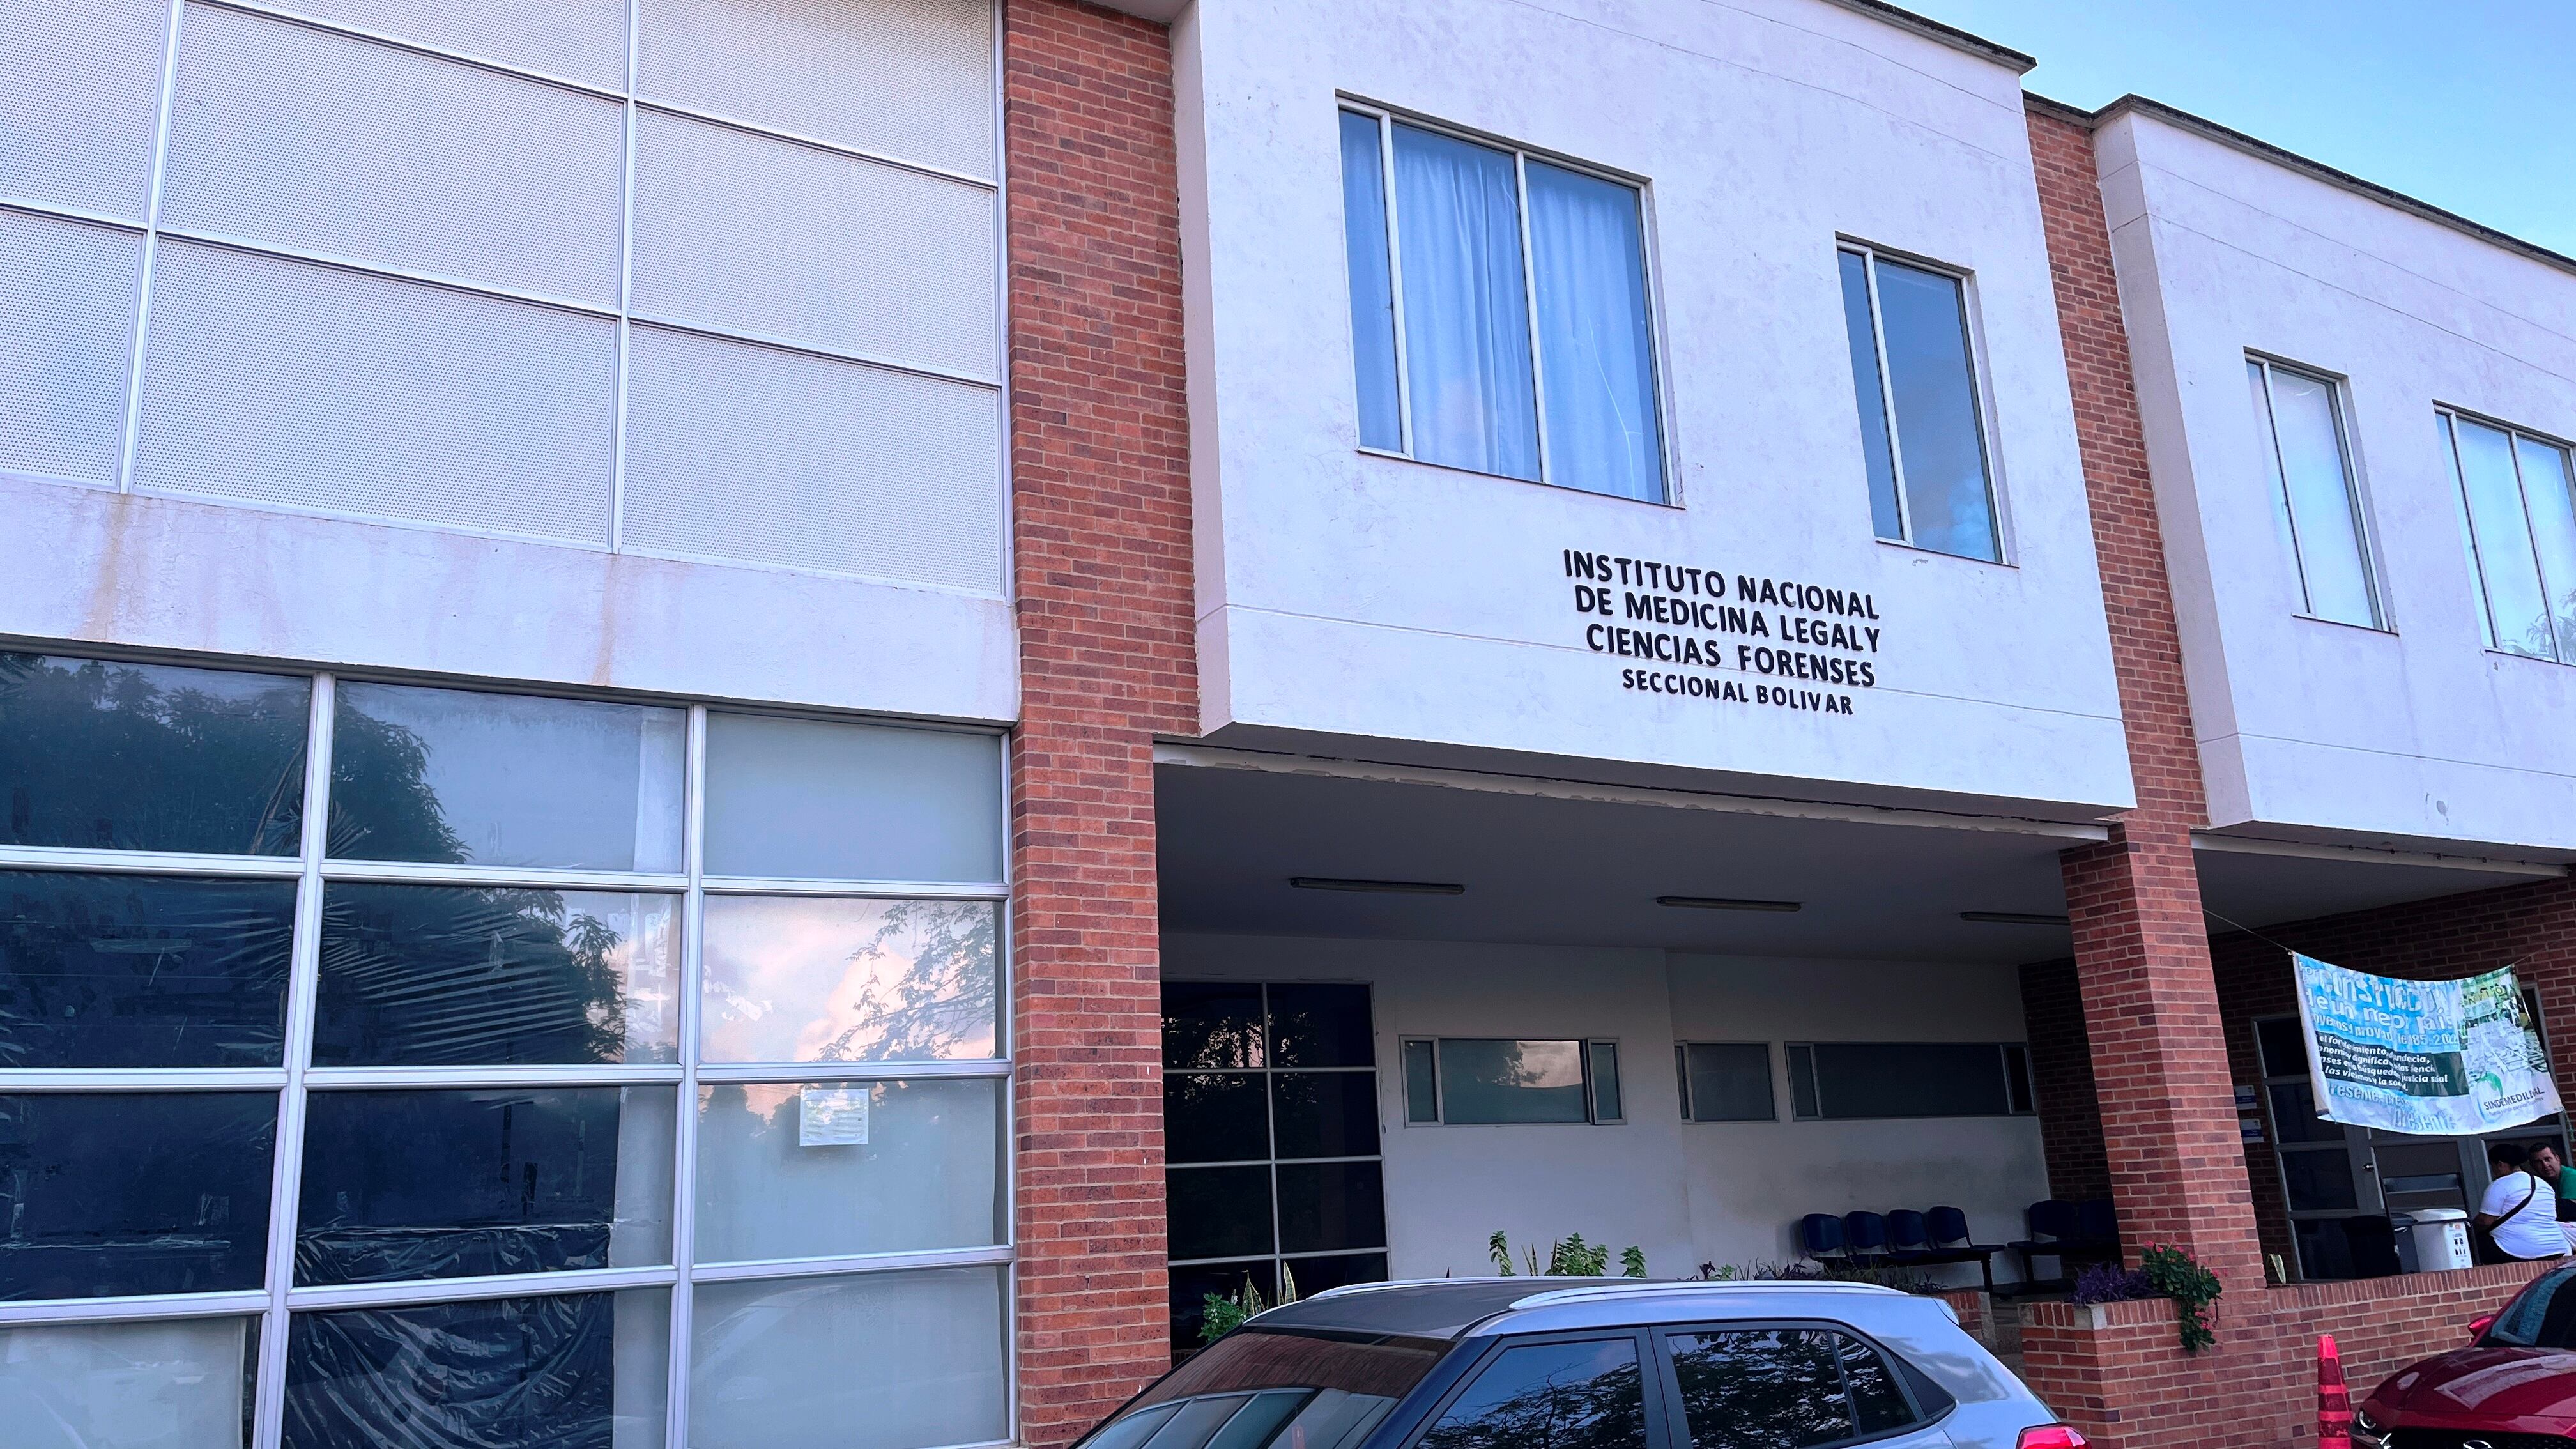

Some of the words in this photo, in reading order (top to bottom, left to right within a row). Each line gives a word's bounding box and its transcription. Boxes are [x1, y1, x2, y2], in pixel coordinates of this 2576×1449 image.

[1564, 549, 1725, 597] INSTITUTO
[1738, 575, 1879, 620] NACIONAL
[1575, 585, 1613, 615] DE
[1625, 592, 1769, 637] MEDICINA
[1587, 624, 1721, 666] CIENCIAS
[1738, 645, 1874, 687] FORENSES
[1623, 669, 1749, 702] SECCIONAL
[1756, 685, 1853, 715] BOLIVAR
[2324, 1066, 2341, 1075] las
[2379, 1077, 2388, 1085] la
